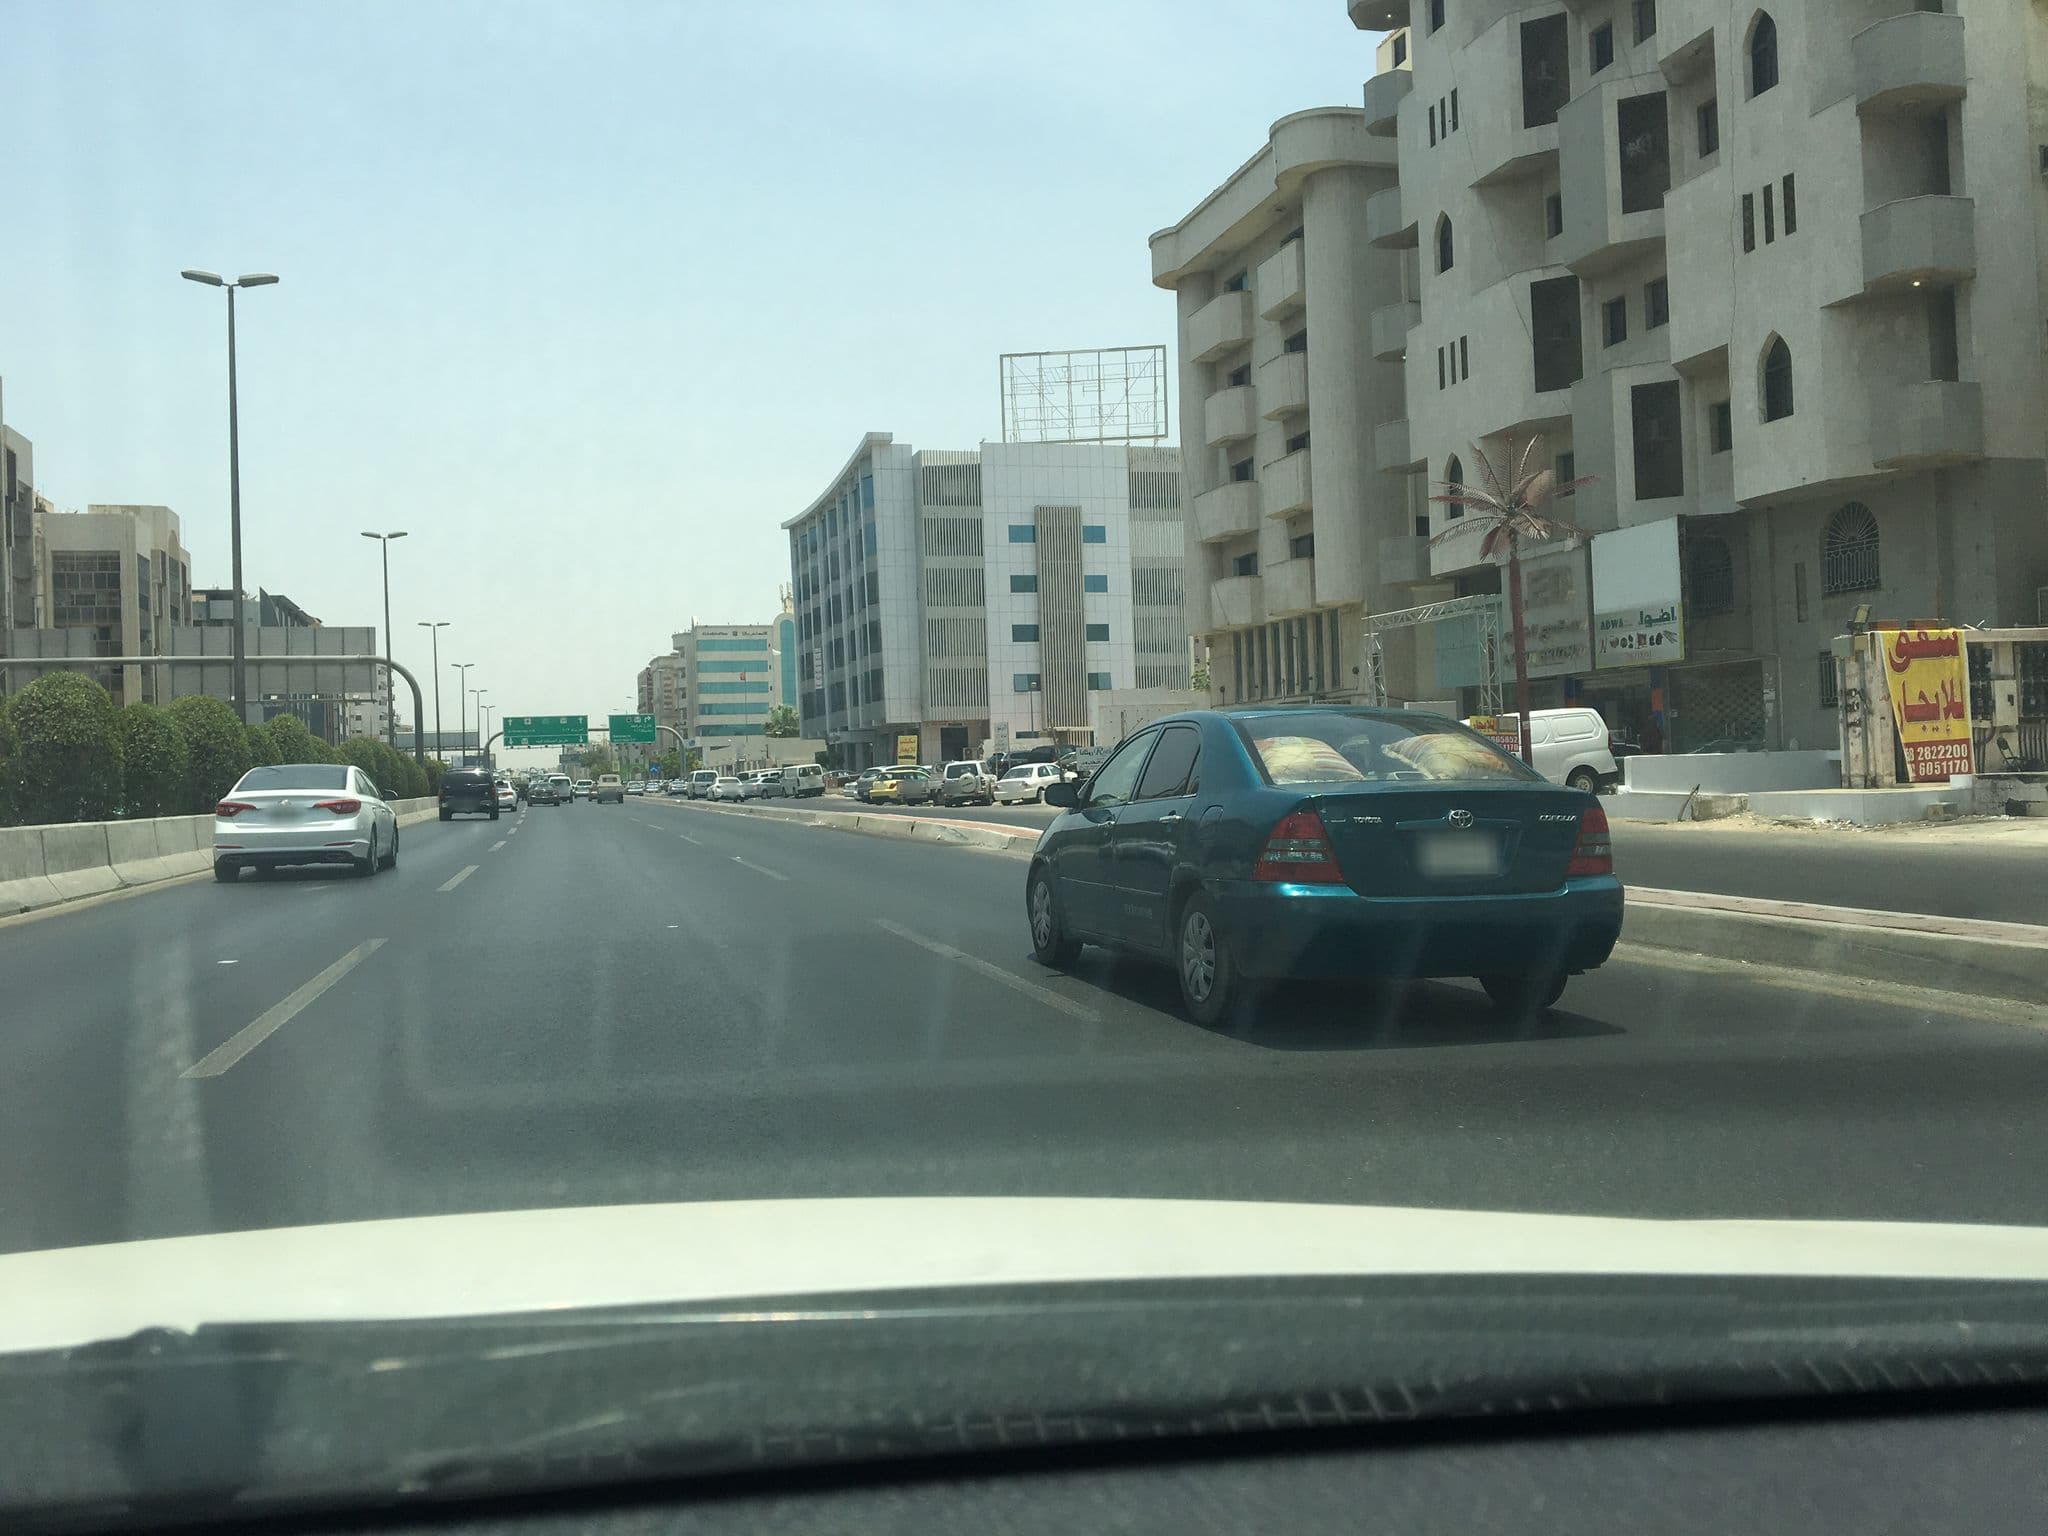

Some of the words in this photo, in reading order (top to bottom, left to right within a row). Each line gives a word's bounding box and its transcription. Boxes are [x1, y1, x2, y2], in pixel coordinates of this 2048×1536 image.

[1600, 618, 1624, 630] ADWA
[1918, 744, 1967, 760] 2822200
[1919, 760, 1969, 776] 6051170
